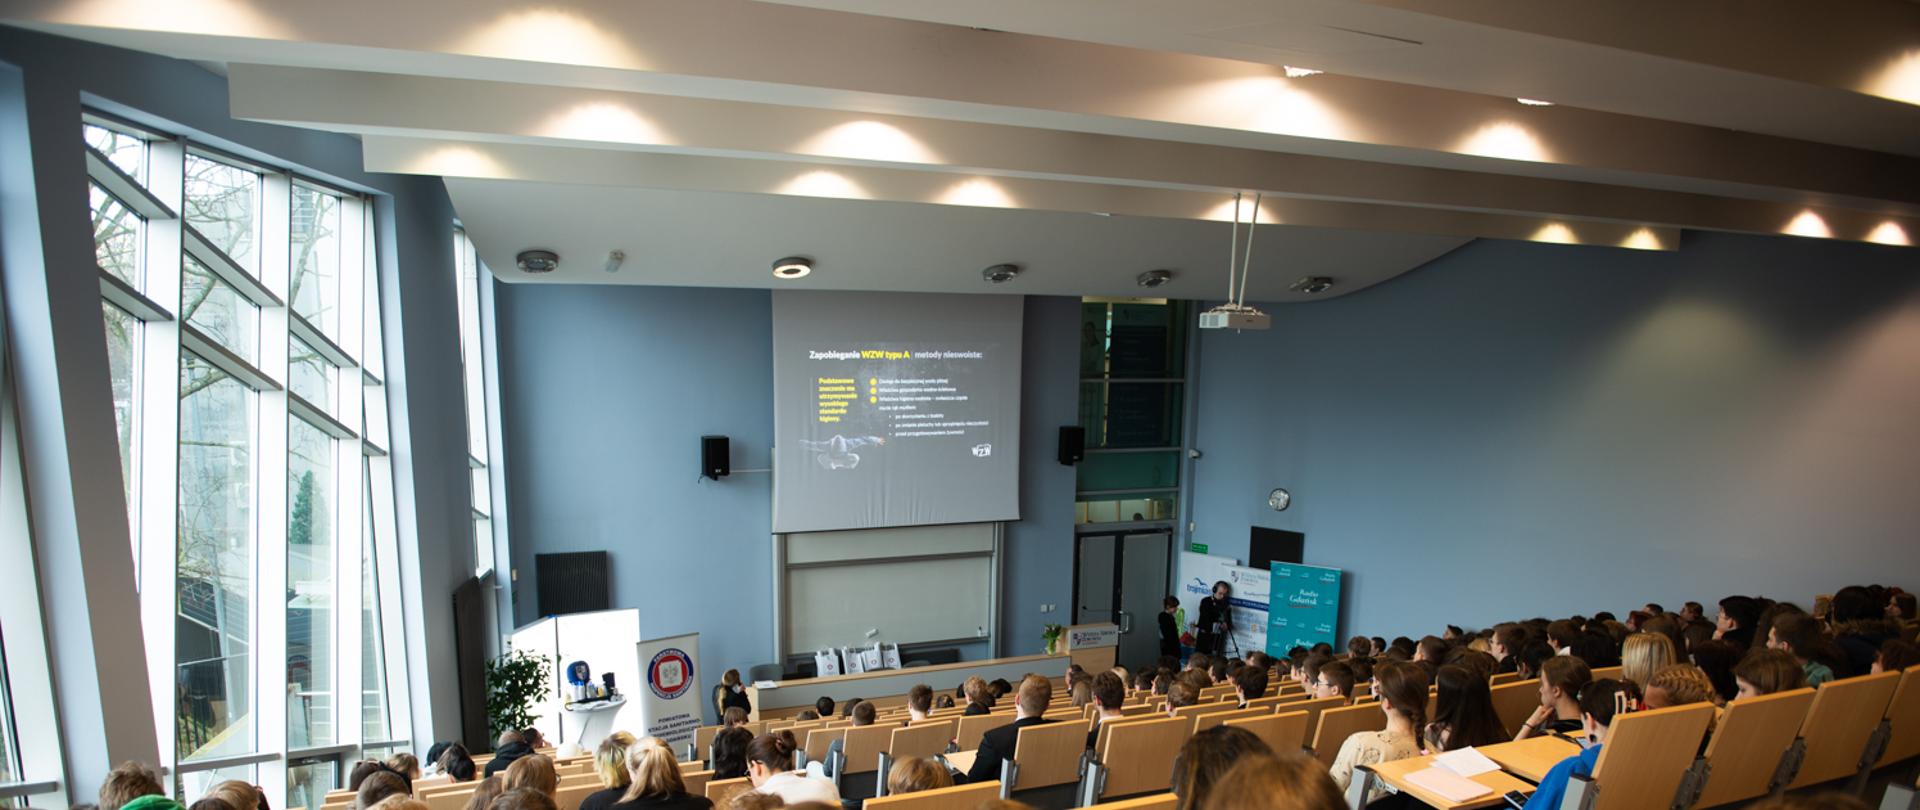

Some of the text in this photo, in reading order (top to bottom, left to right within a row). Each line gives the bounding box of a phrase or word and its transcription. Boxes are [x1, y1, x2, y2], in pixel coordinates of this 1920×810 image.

[808, 350, 860, 361] Zapobieganie
[860, 350, 884, 360] WZW
[885, 351, 902, 361] typu
[903, 350, 911, 360] A
[914, 350, 942, 361] metody
[1299, 588, 1319, 598] Radio
[1289, 594, 1318, 605] Gdańsk
